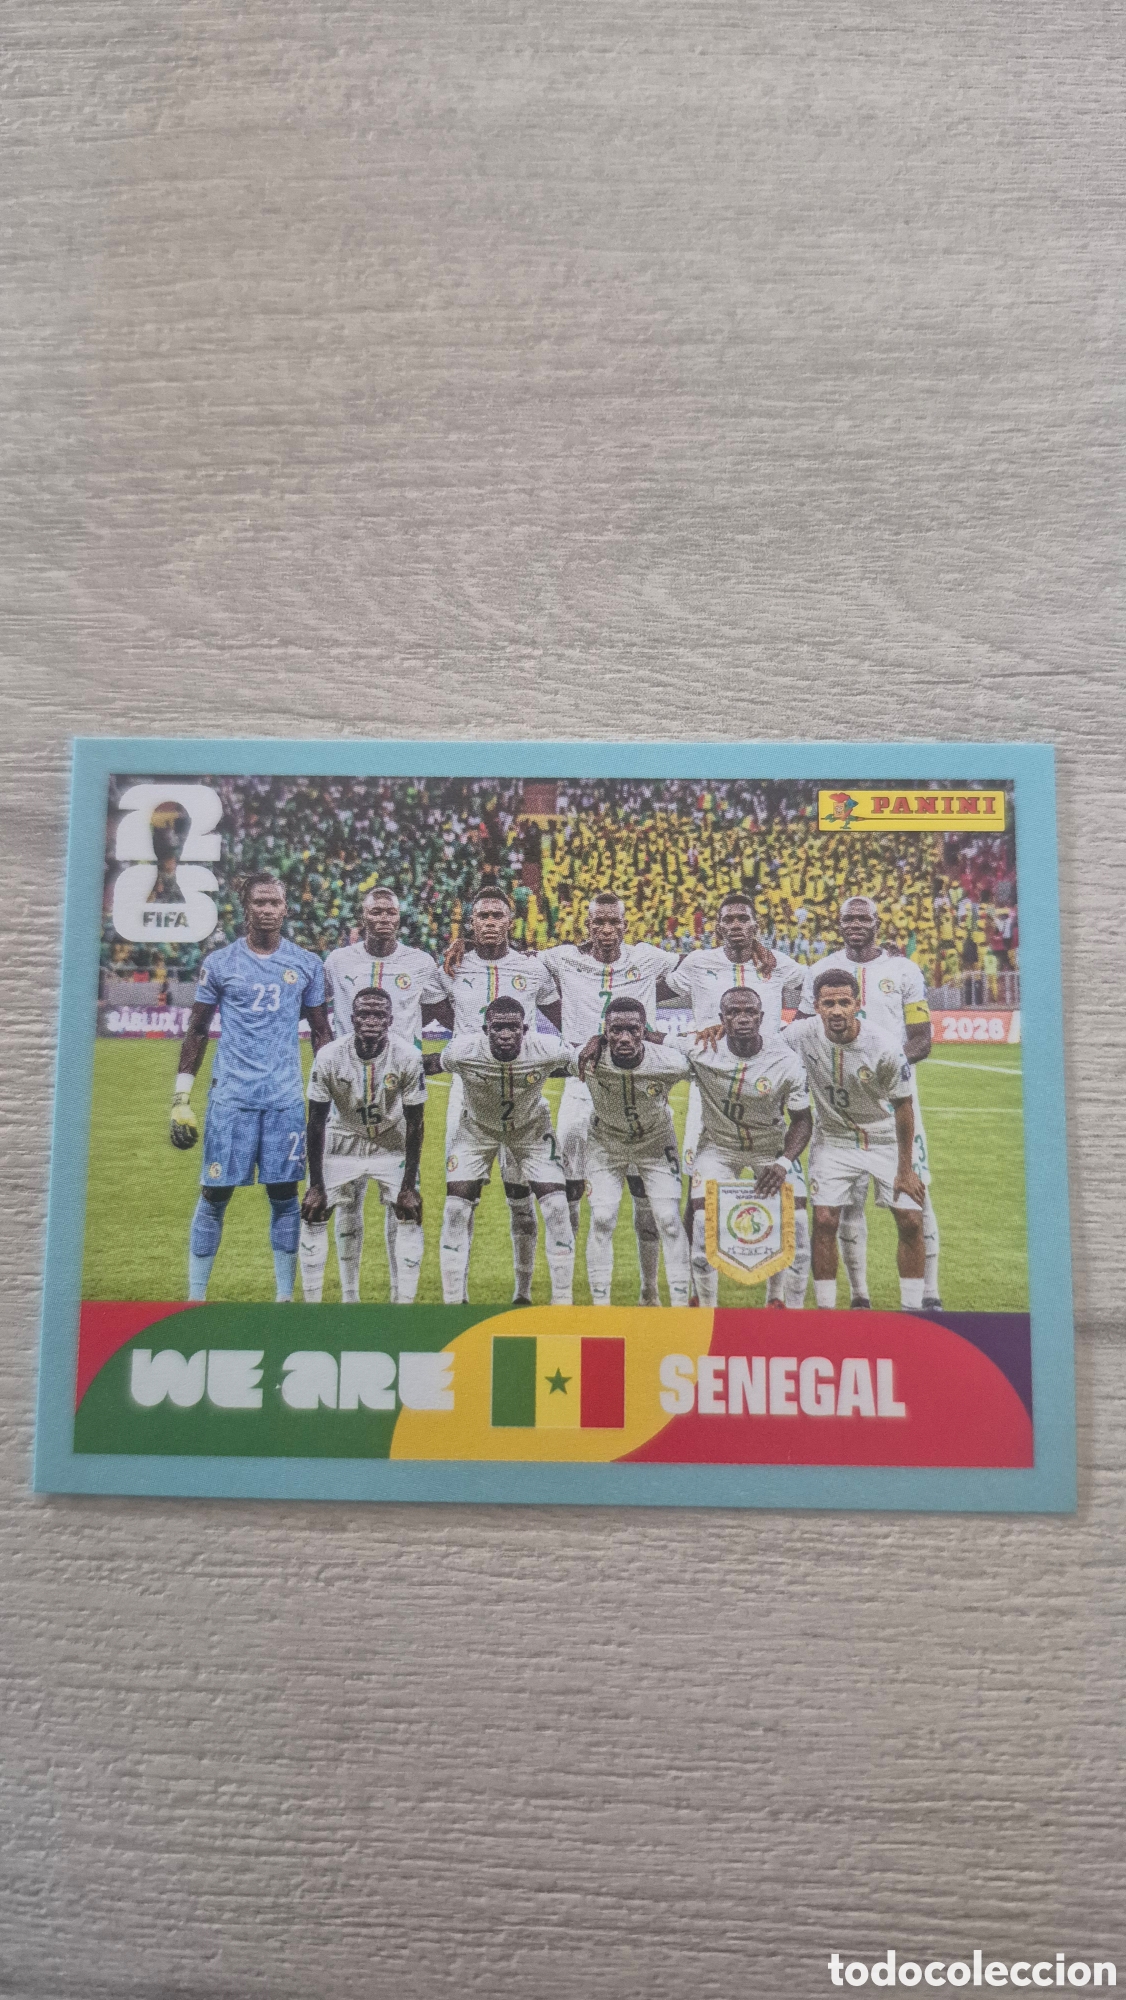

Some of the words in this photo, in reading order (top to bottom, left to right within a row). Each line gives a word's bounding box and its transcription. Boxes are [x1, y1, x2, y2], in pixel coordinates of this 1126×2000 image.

[871, 795, 997, 815] PANINI
[142, 912, 189, 928] FIFA
[252, 983, 281, 1012] 23
[599, 991, 612, 1018] 7
[825, 1085, 850, 1108] 13
[356, 1104, 382, 1125] 15
[501, 1101, 515, 1120] 2
[624, 1106, 638, 1122] 5
[721, 1099, 744, 1121] 10
[543, 1133, 561, 1160] 2
[127, 1348, 263, 1408] WE
[278, 1351, 455, 1411] ARE
[658, 1353, 907, 1418] SENEGAL
